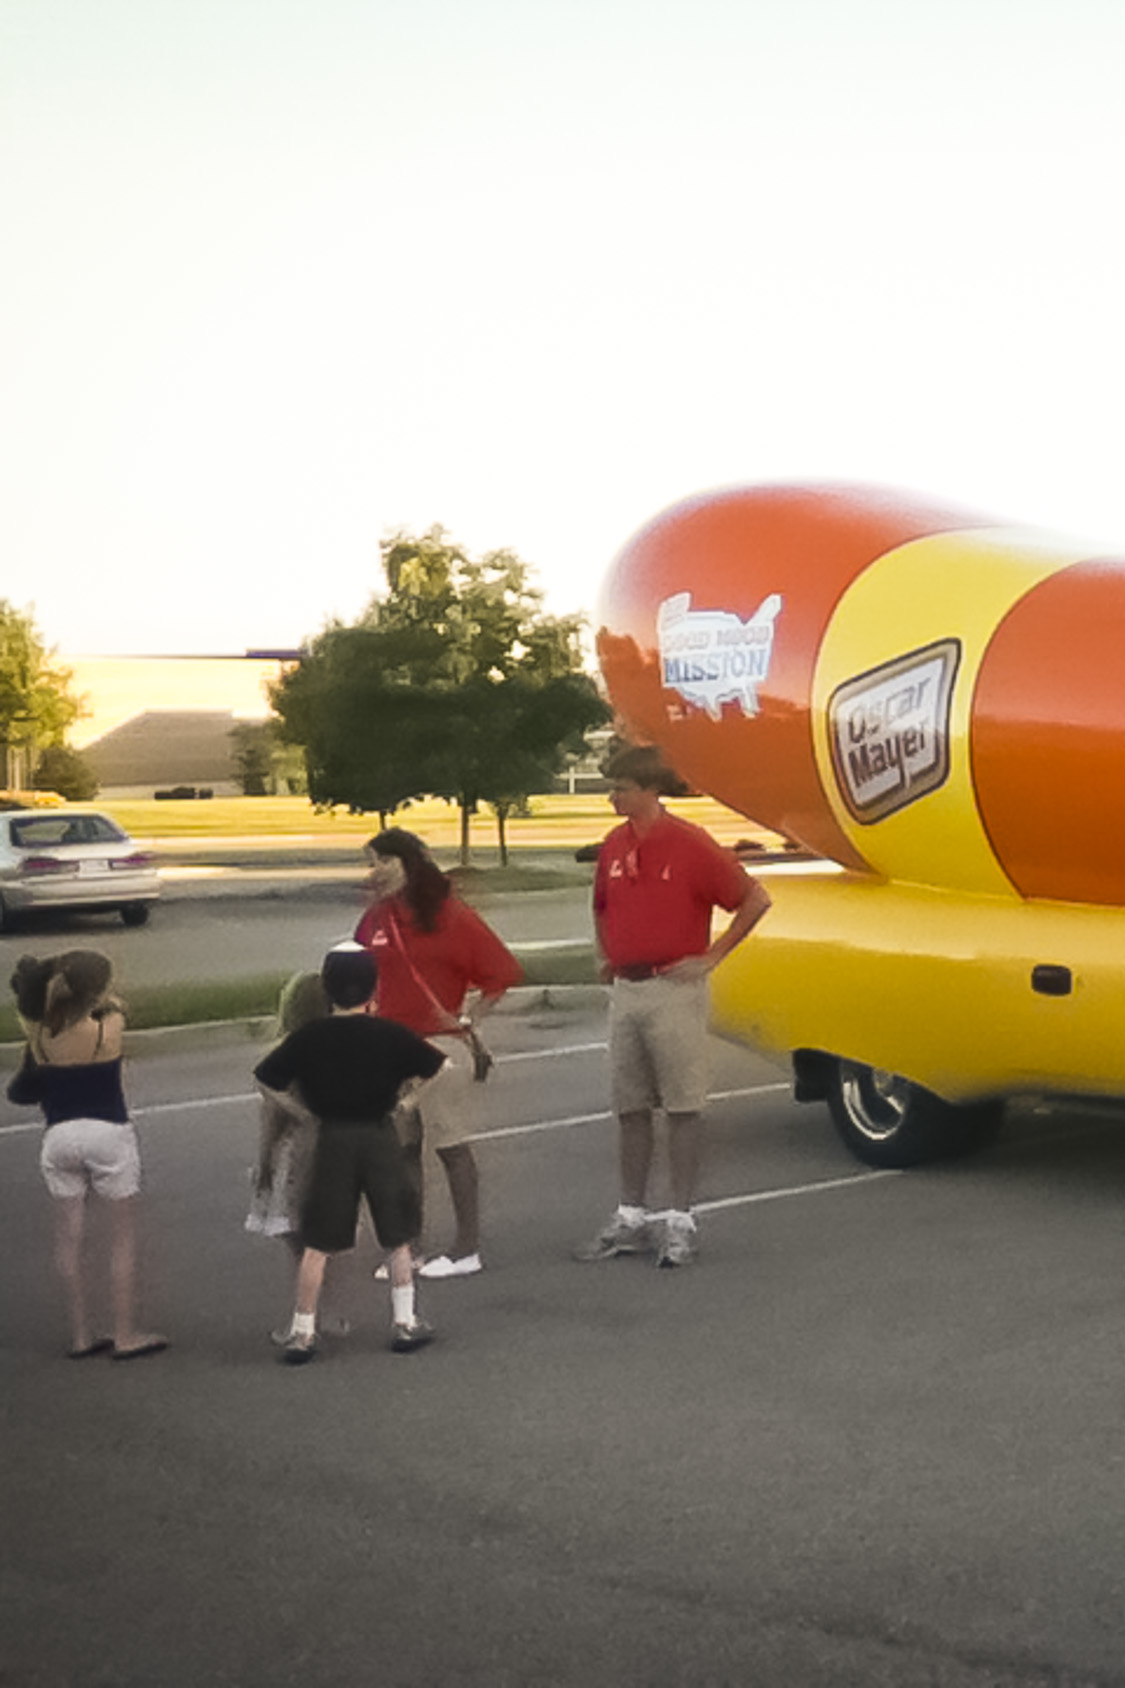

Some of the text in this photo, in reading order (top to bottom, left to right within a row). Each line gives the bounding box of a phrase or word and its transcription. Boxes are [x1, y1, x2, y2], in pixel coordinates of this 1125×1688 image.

[664, 647, 767, 683] MISSION
[848, 676, 932, 744] Oscar
[848, 716, 929, 789] Mayer
